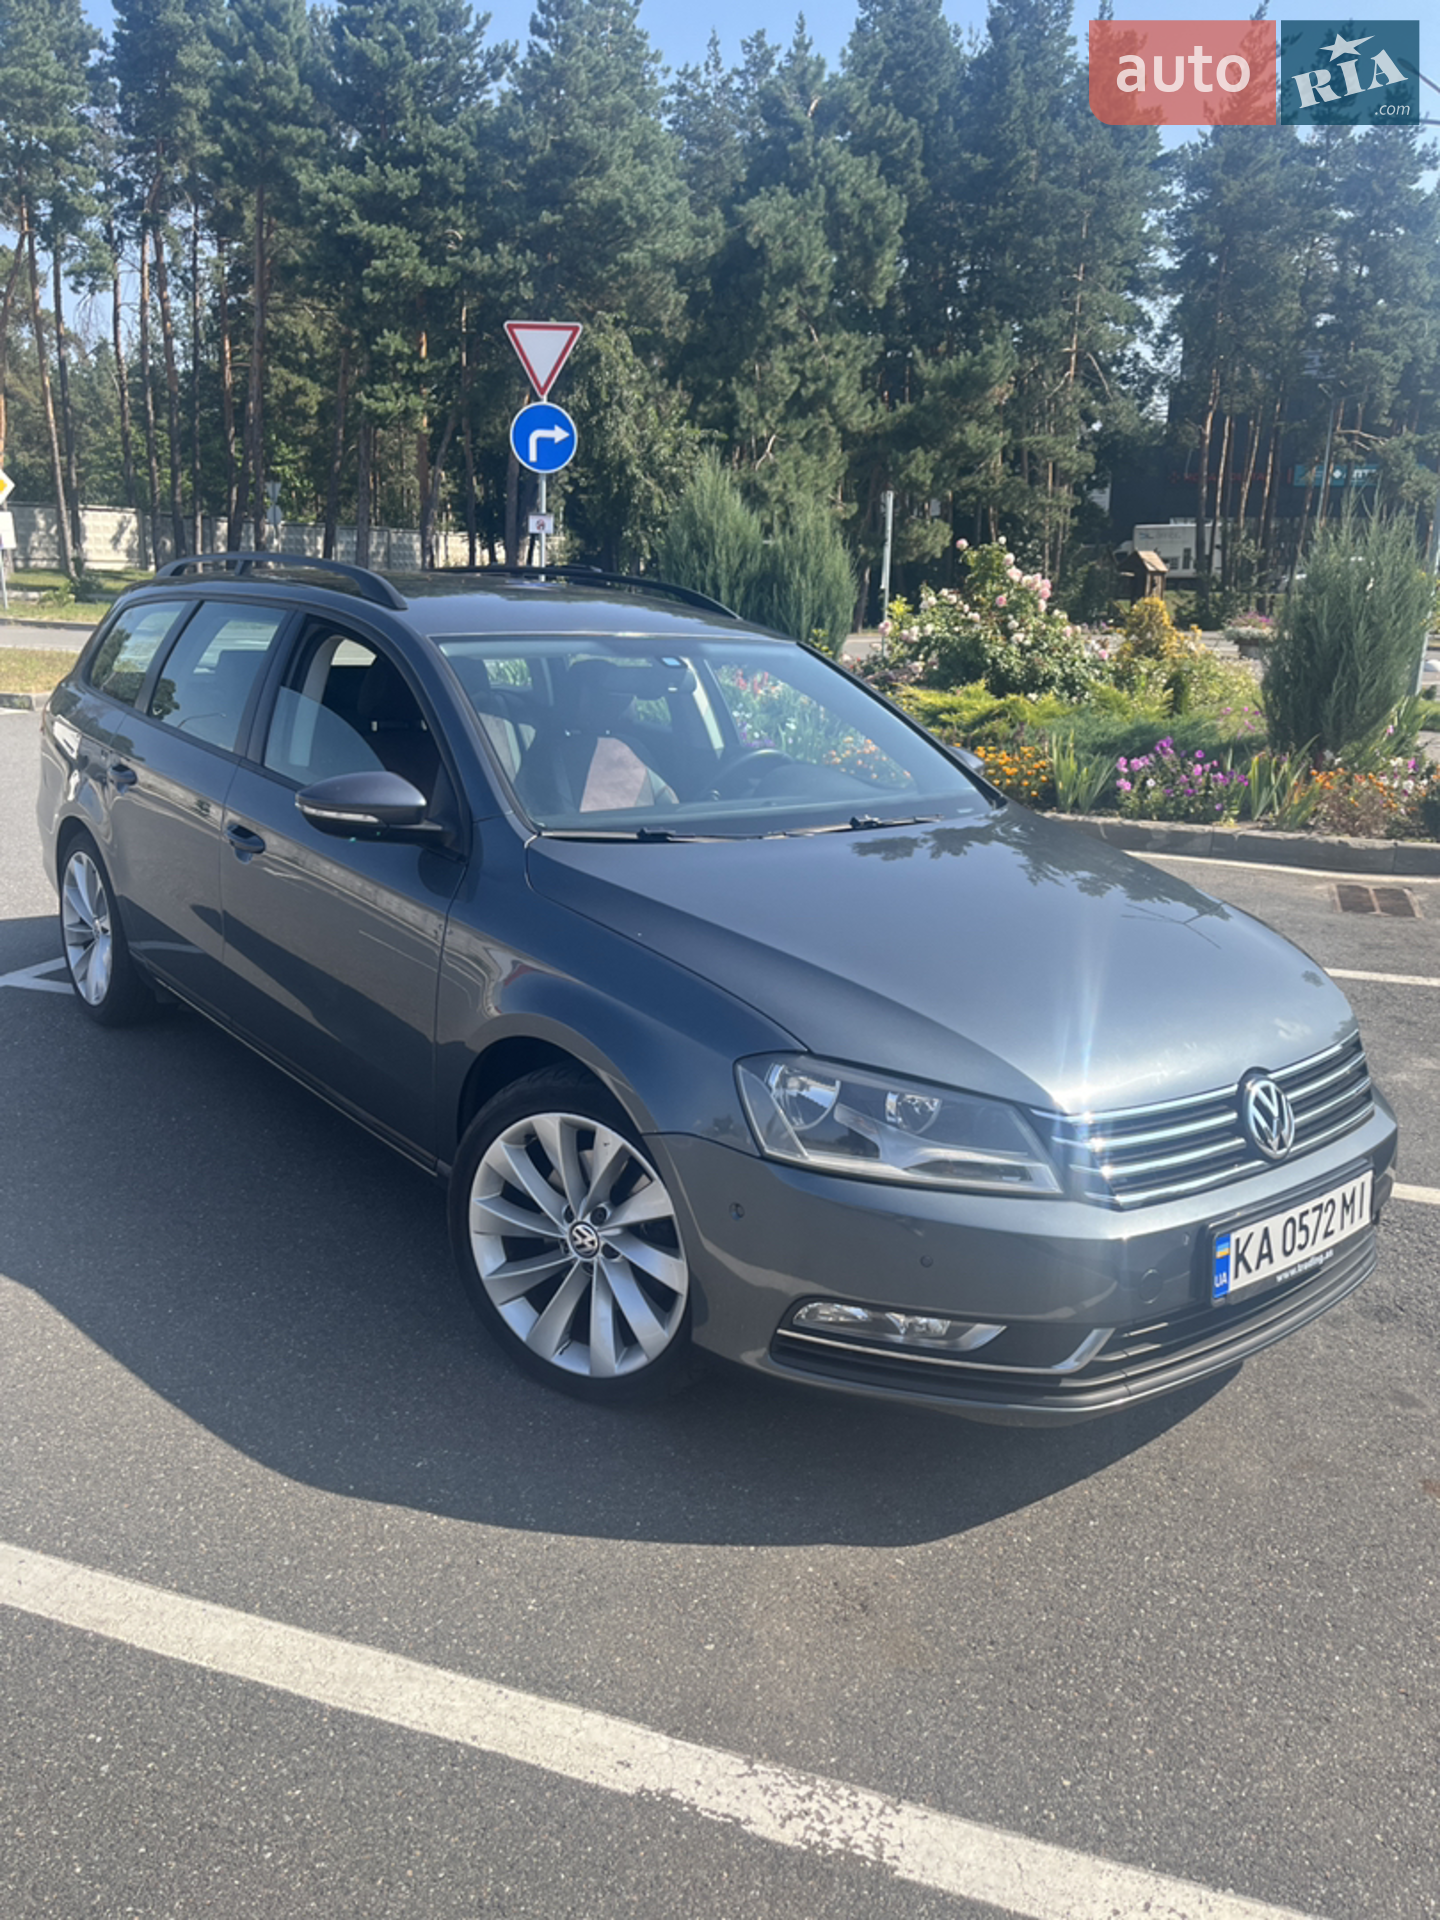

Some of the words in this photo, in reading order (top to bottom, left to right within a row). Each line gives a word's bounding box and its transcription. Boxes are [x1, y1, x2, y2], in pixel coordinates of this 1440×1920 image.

[1234, 1226, 1274, 1280] KA
[1282, 1198, 1336, 1258] 0572
[1340, 1181, 1366, 1231] MI
[1214, 1272, 1228, 1288] UA
